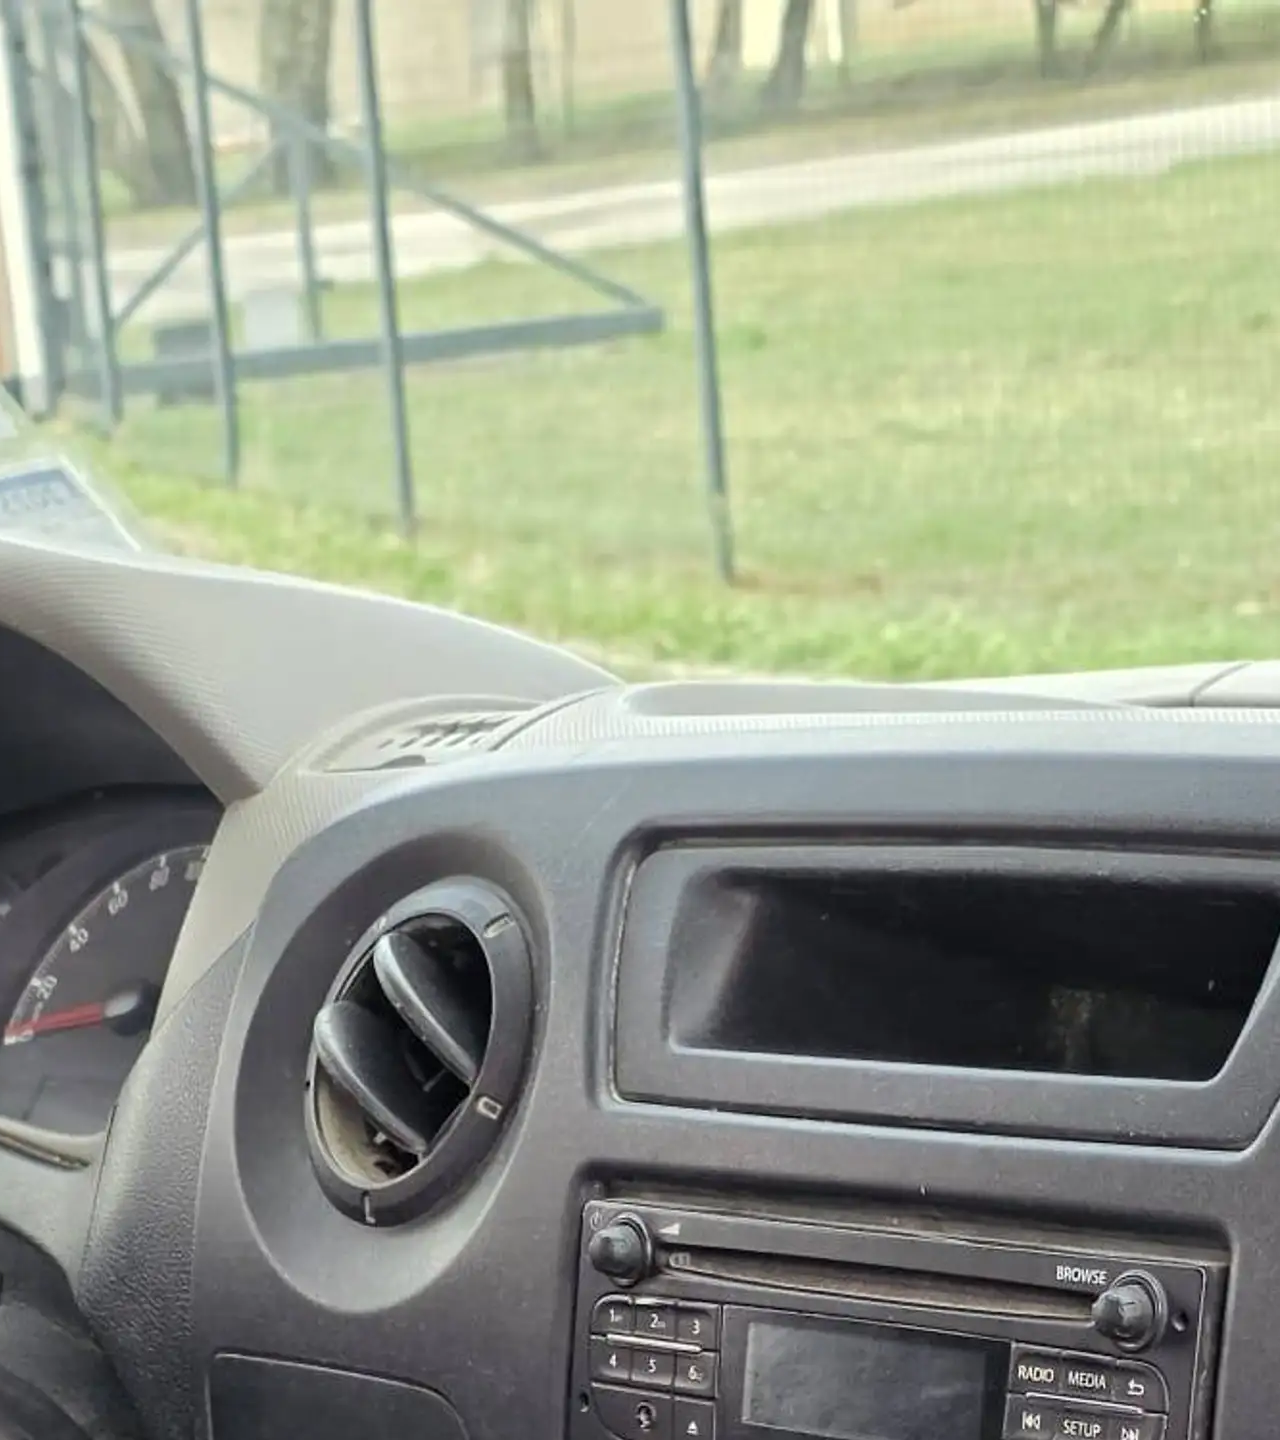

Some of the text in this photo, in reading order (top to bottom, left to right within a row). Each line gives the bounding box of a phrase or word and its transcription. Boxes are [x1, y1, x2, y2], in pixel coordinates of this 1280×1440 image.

[1055, 1264, 1108, 1285] BROWSE
[691, 1318, 702, 1335] 3
[608, 1353, 618, 1369] 4
[647, 1357, 658, 1374] 5
[1017, 1364, 1055, 1384] RADIO
[1068, 1370, 1107, 1389] MEDIA
[1062, 1421, 1102, 1439] SETUP
